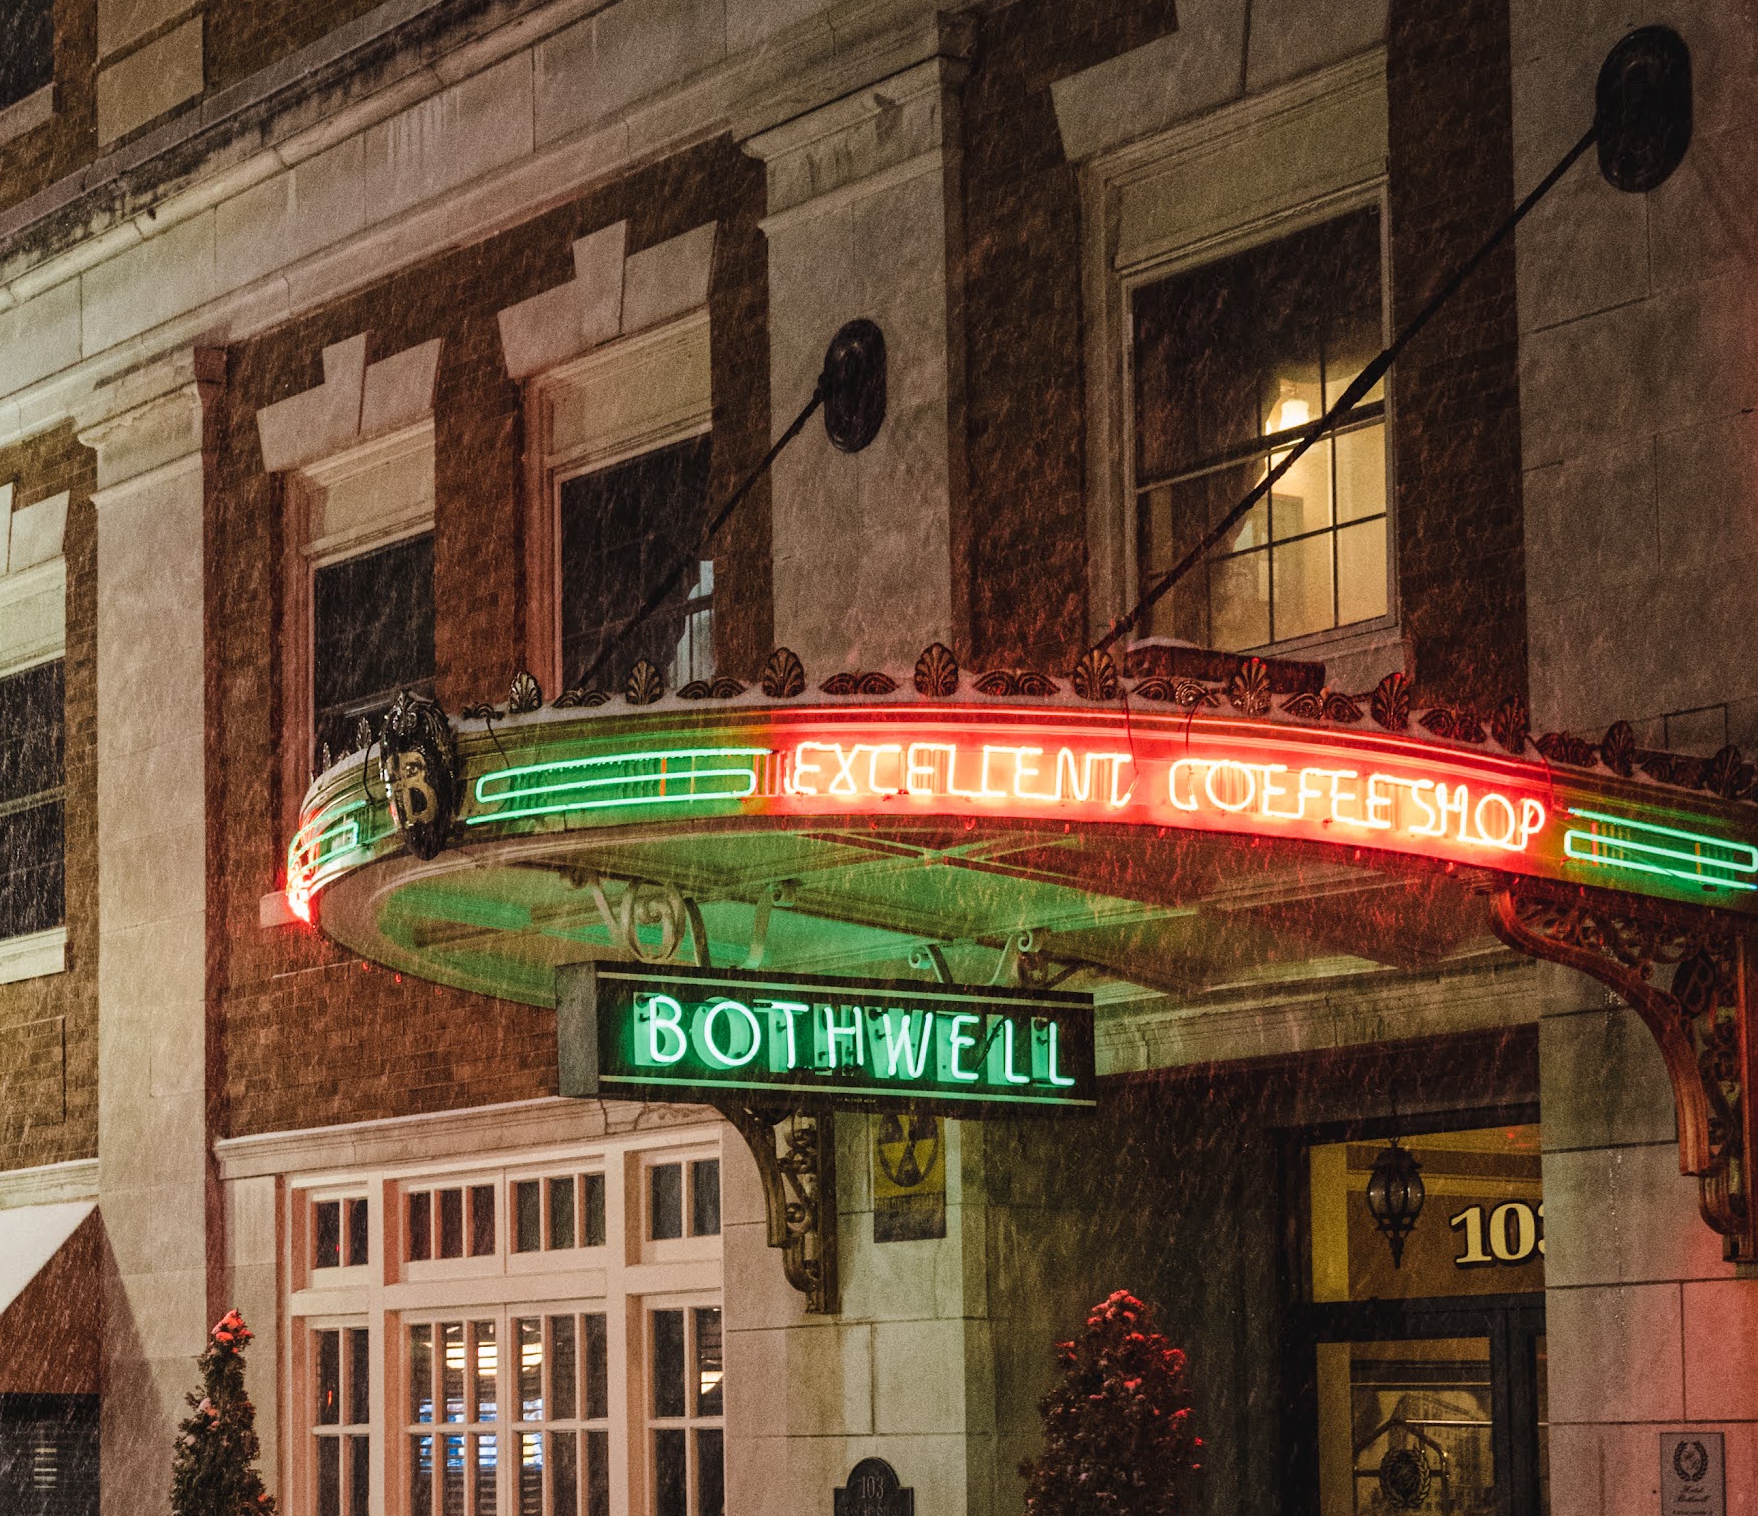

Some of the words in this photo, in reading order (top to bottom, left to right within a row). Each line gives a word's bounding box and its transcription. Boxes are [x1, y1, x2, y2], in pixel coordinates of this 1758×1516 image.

[785, 741, 1134, 807] EXCELLENT
[634, 992, 1076, 1088] BOTHWELL
[1449, 1200, 1546, 1267] 10
[861, 1475, 884, 1499] 103
